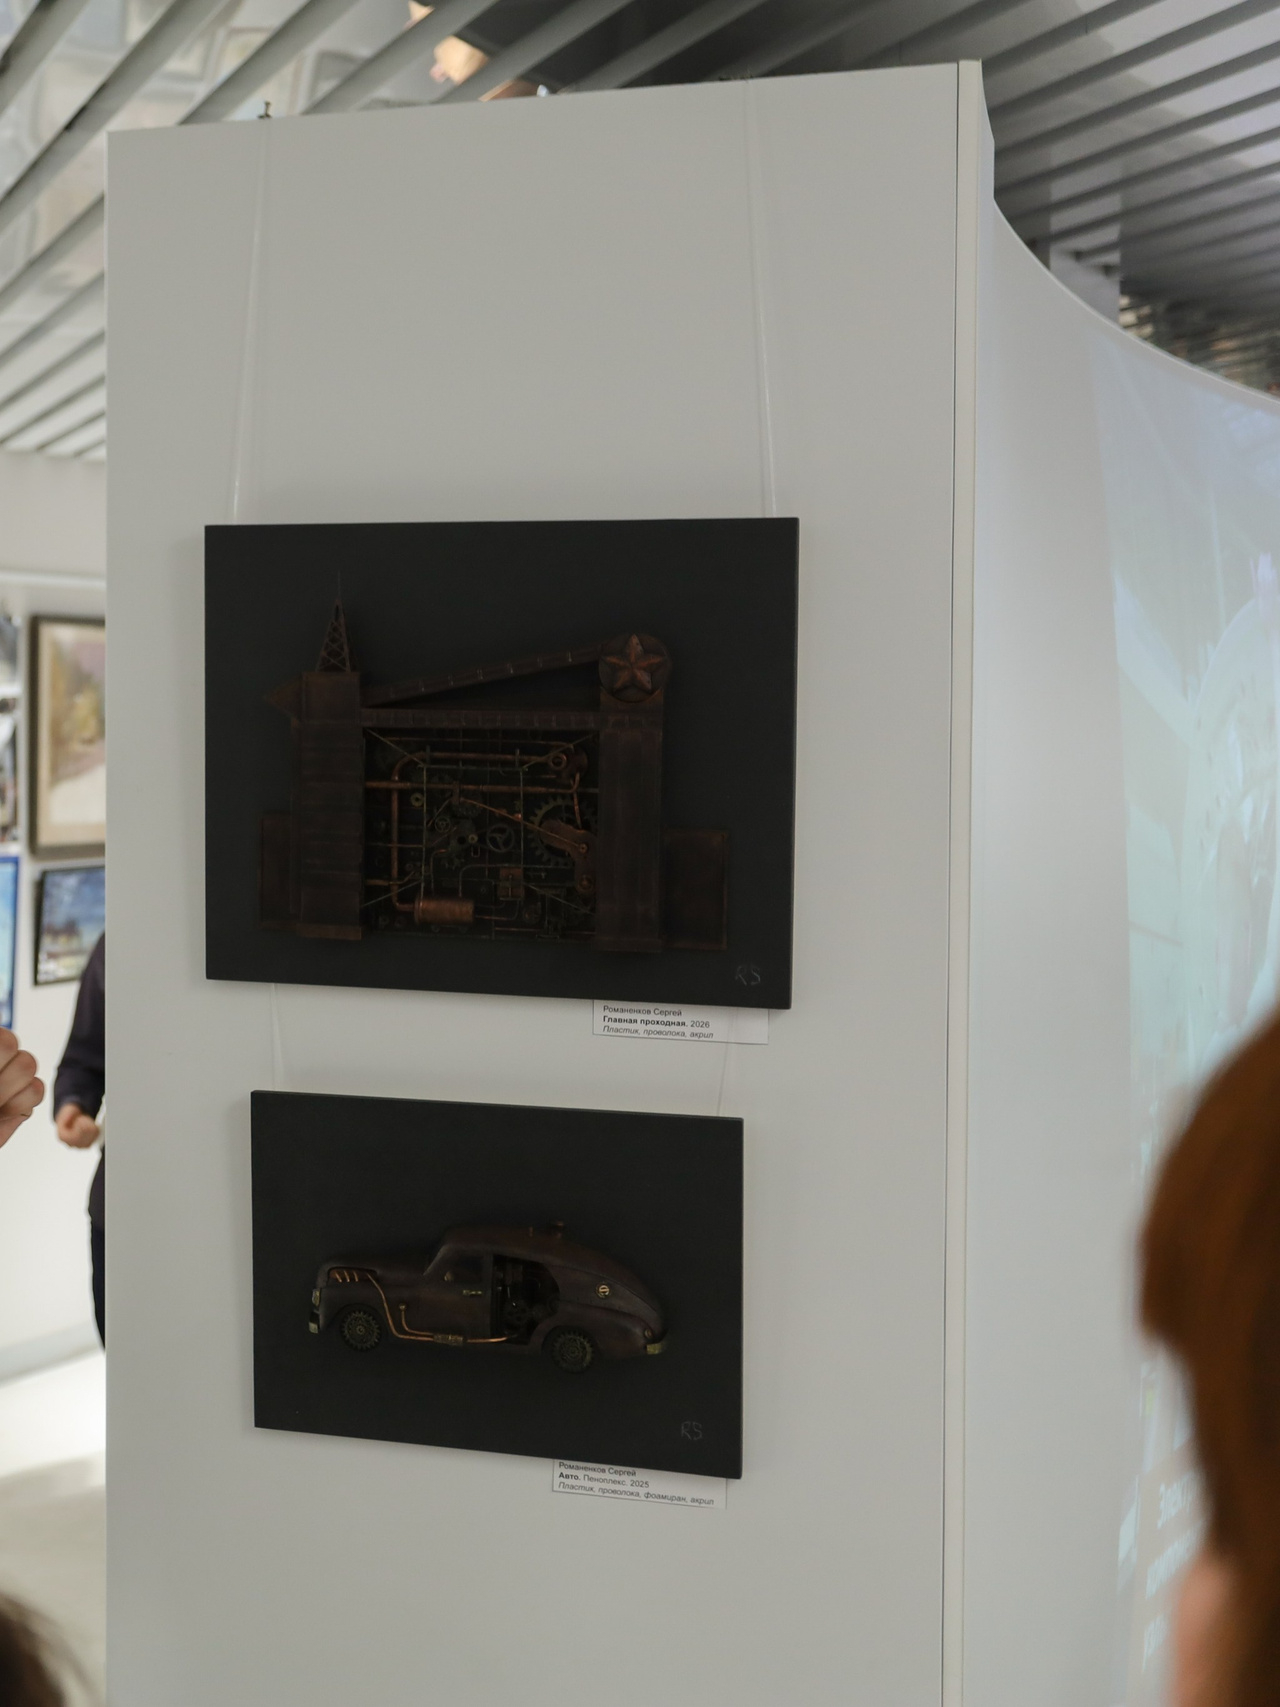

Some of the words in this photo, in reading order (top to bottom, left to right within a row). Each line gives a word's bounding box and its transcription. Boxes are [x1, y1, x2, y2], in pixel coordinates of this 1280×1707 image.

[603, 1004, 652, 1016] Романенков
[654, 1008, 682, 1018] Сергей
[603, 1015, 638, 1025] Главная
[640, 1018, 688, 1028] проходная.
[602, 1025, 641, 1036] Пластик,
[643, 1028, 688, 1039] проволока,
[689, 1031, 714, 1040] акрил
[558, 1461, 606, 1474] Романенков
[607, 1467, 636, 1478] Сергей
[558, 1472, 581, 1481] Авто.
[630, 1479, 650, 1489] 2025
[557, 1482, 596, 1493] Пластик,
[598, 1487, 642, 1499] проволока,
[644, 1492, 688, 1504] фоамиран,
[689, 1496, 715, 1506] акрил
